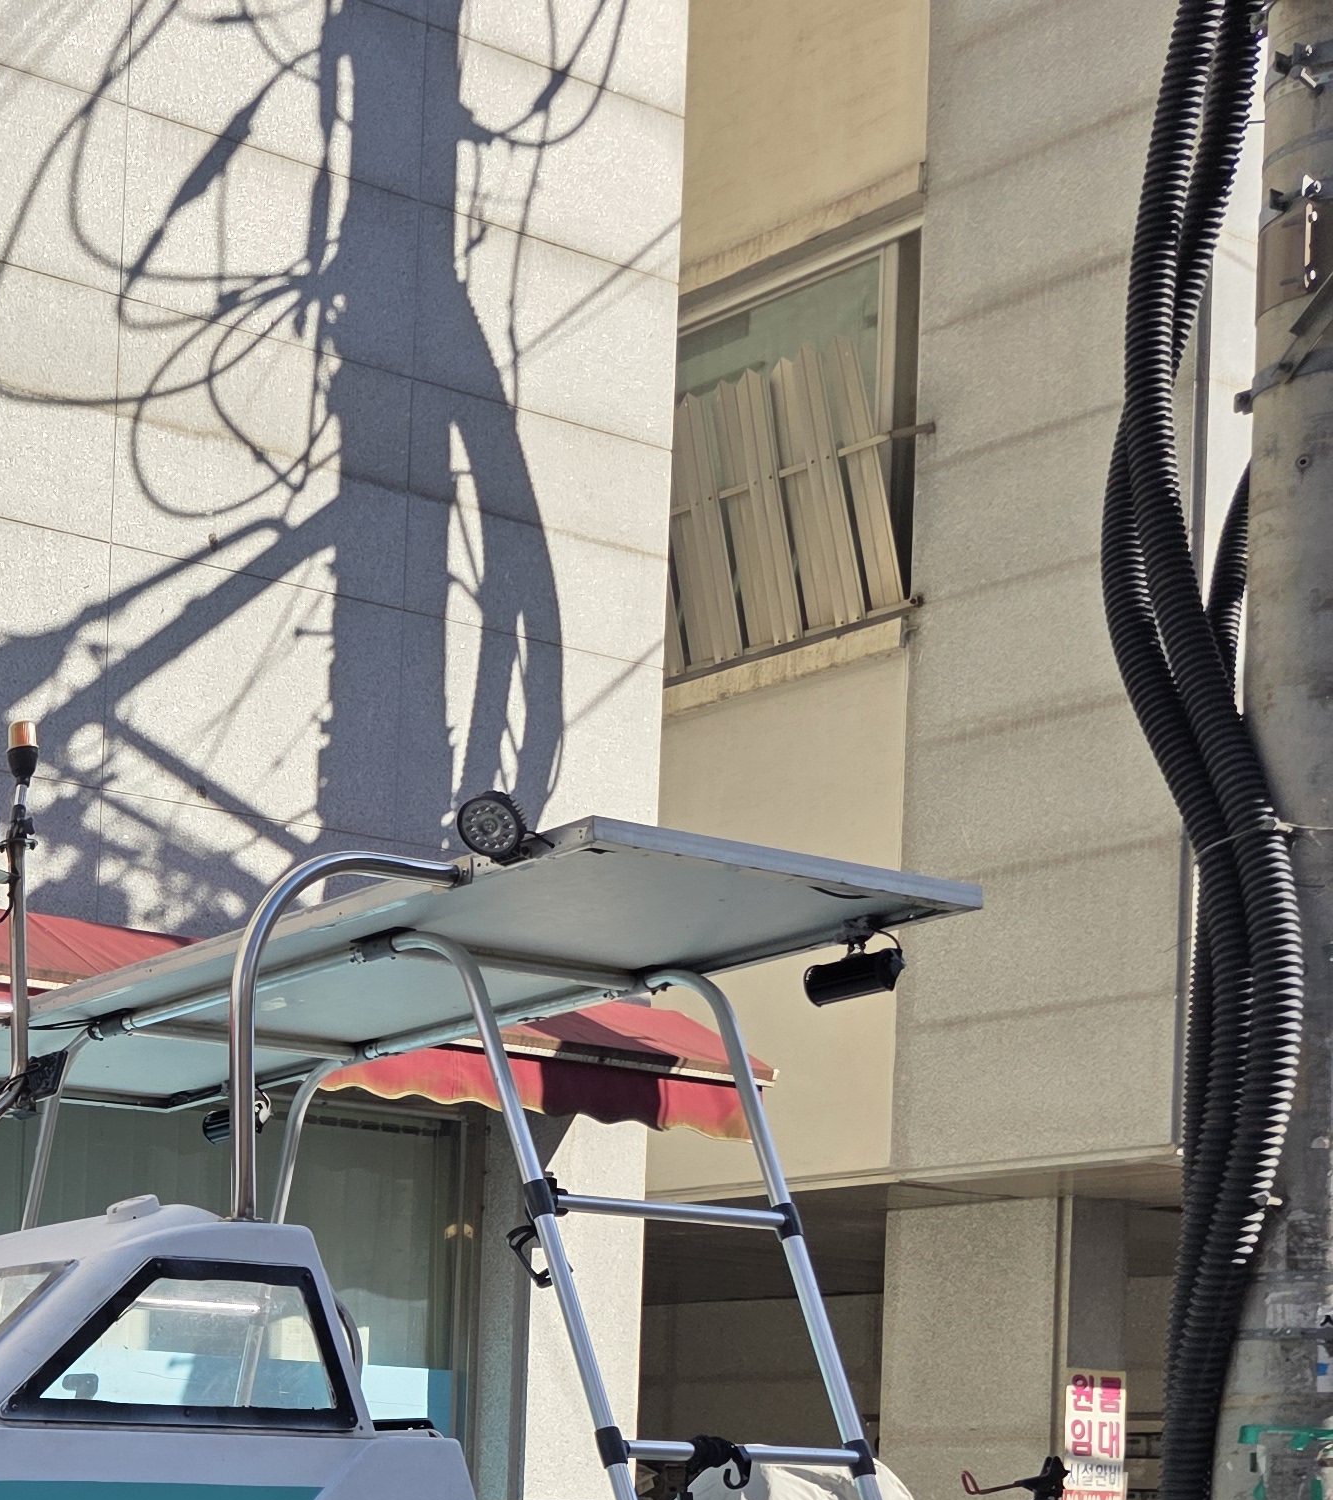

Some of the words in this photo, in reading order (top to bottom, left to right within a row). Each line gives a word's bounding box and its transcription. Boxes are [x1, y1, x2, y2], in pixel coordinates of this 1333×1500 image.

[1071, 1374, 1122, 1413] 원룸
[1070, 1419, 1120, 1458] 임대
[1067, 1463, 1121, 1487] 시설완비
